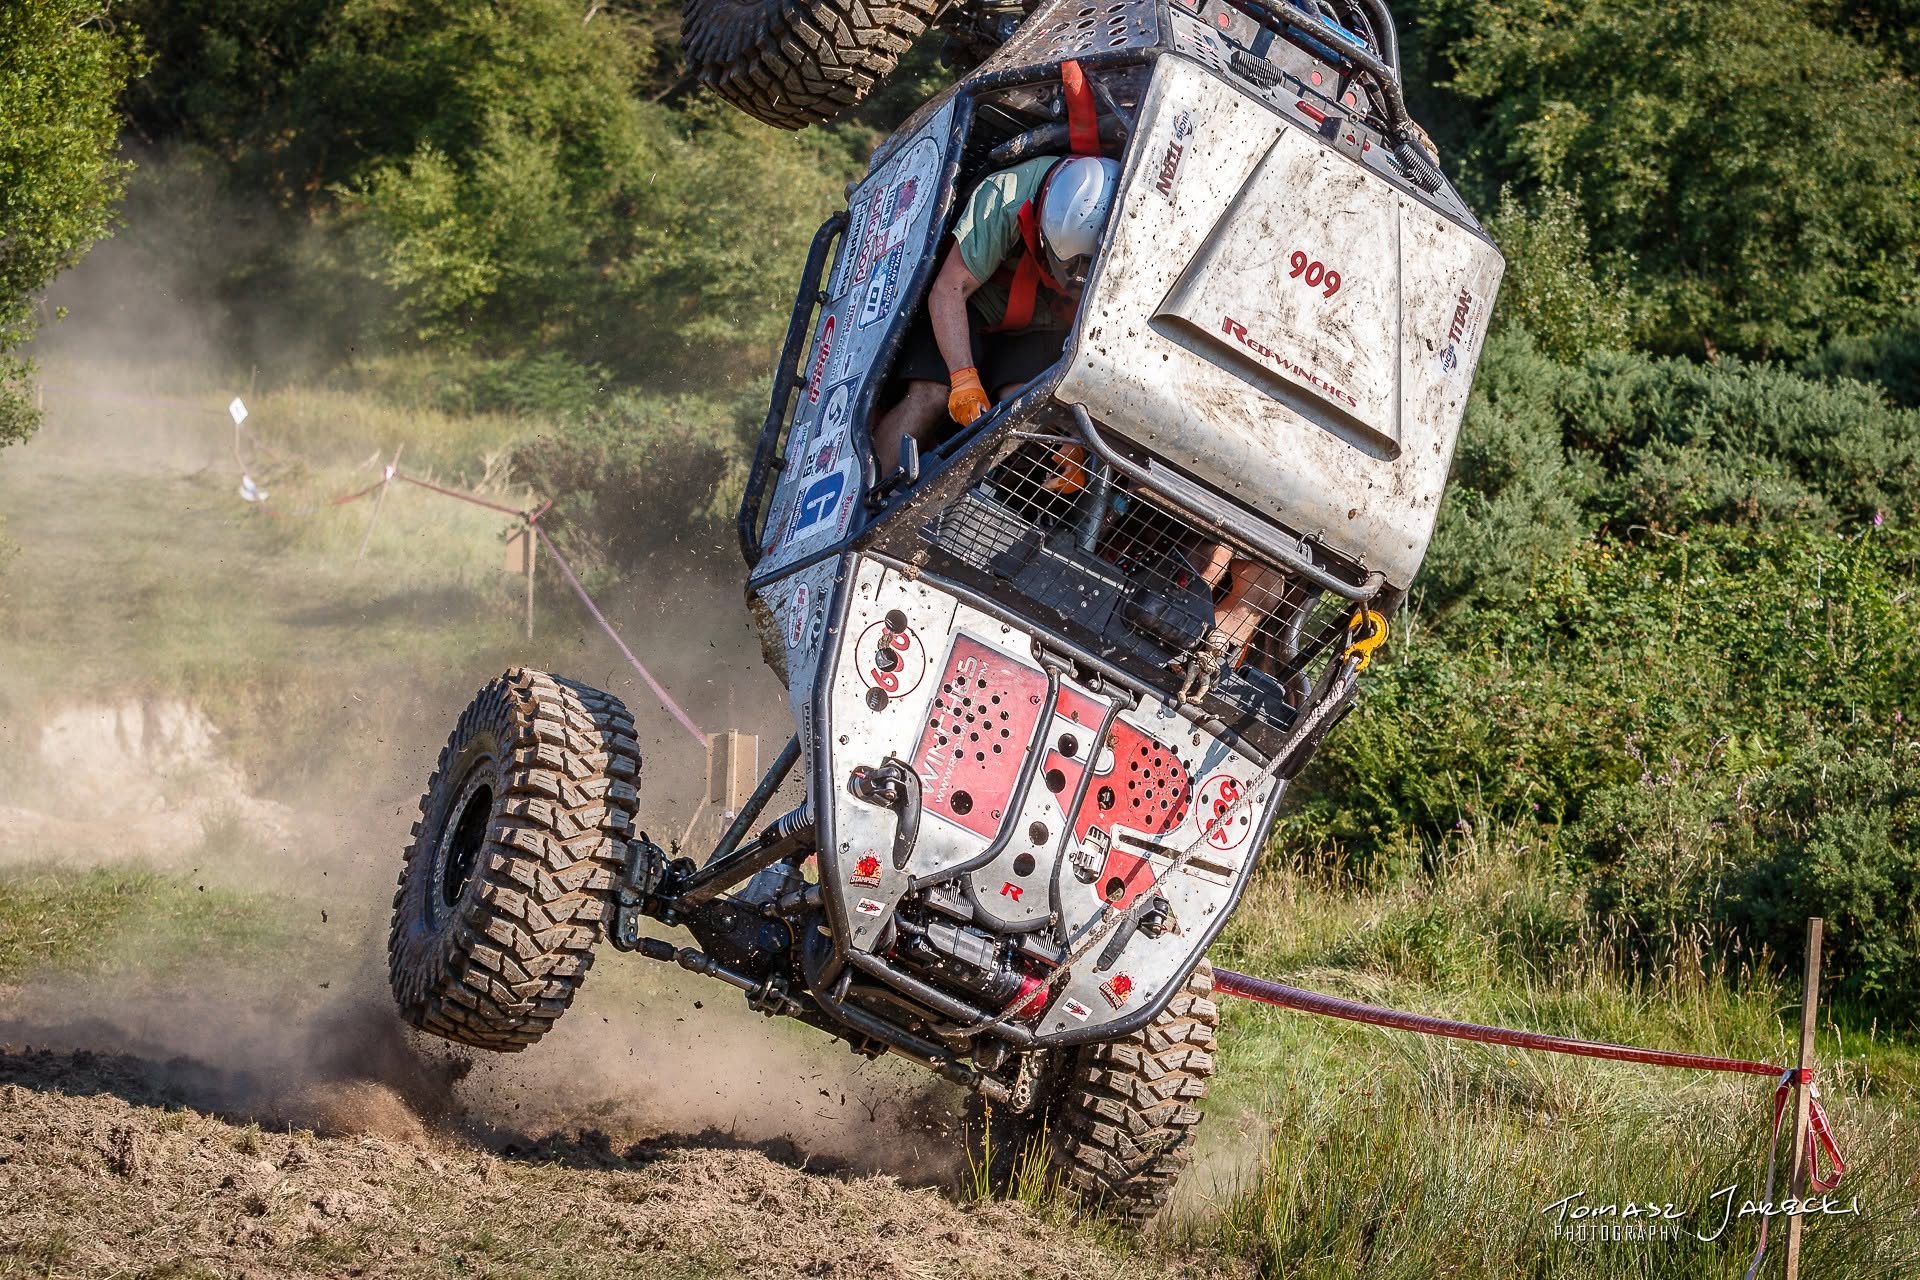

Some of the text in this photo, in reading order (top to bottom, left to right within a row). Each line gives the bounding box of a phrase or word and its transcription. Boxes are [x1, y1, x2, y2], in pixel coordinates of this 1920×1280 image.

[1156, 110, 1190, 197] FUCHS TITAN
[891, 245, 903, 281] OWLIN
[1289, 250, 1341, 298] 909
[1449, 287, 1472, 344] TITAN
[1443, 343, 1455, 373] FUCHS
[793, 588, 806, 641] HWE
[919, 656, 977, 793] WINCHES
[1000, 881, 1024, 904] R
